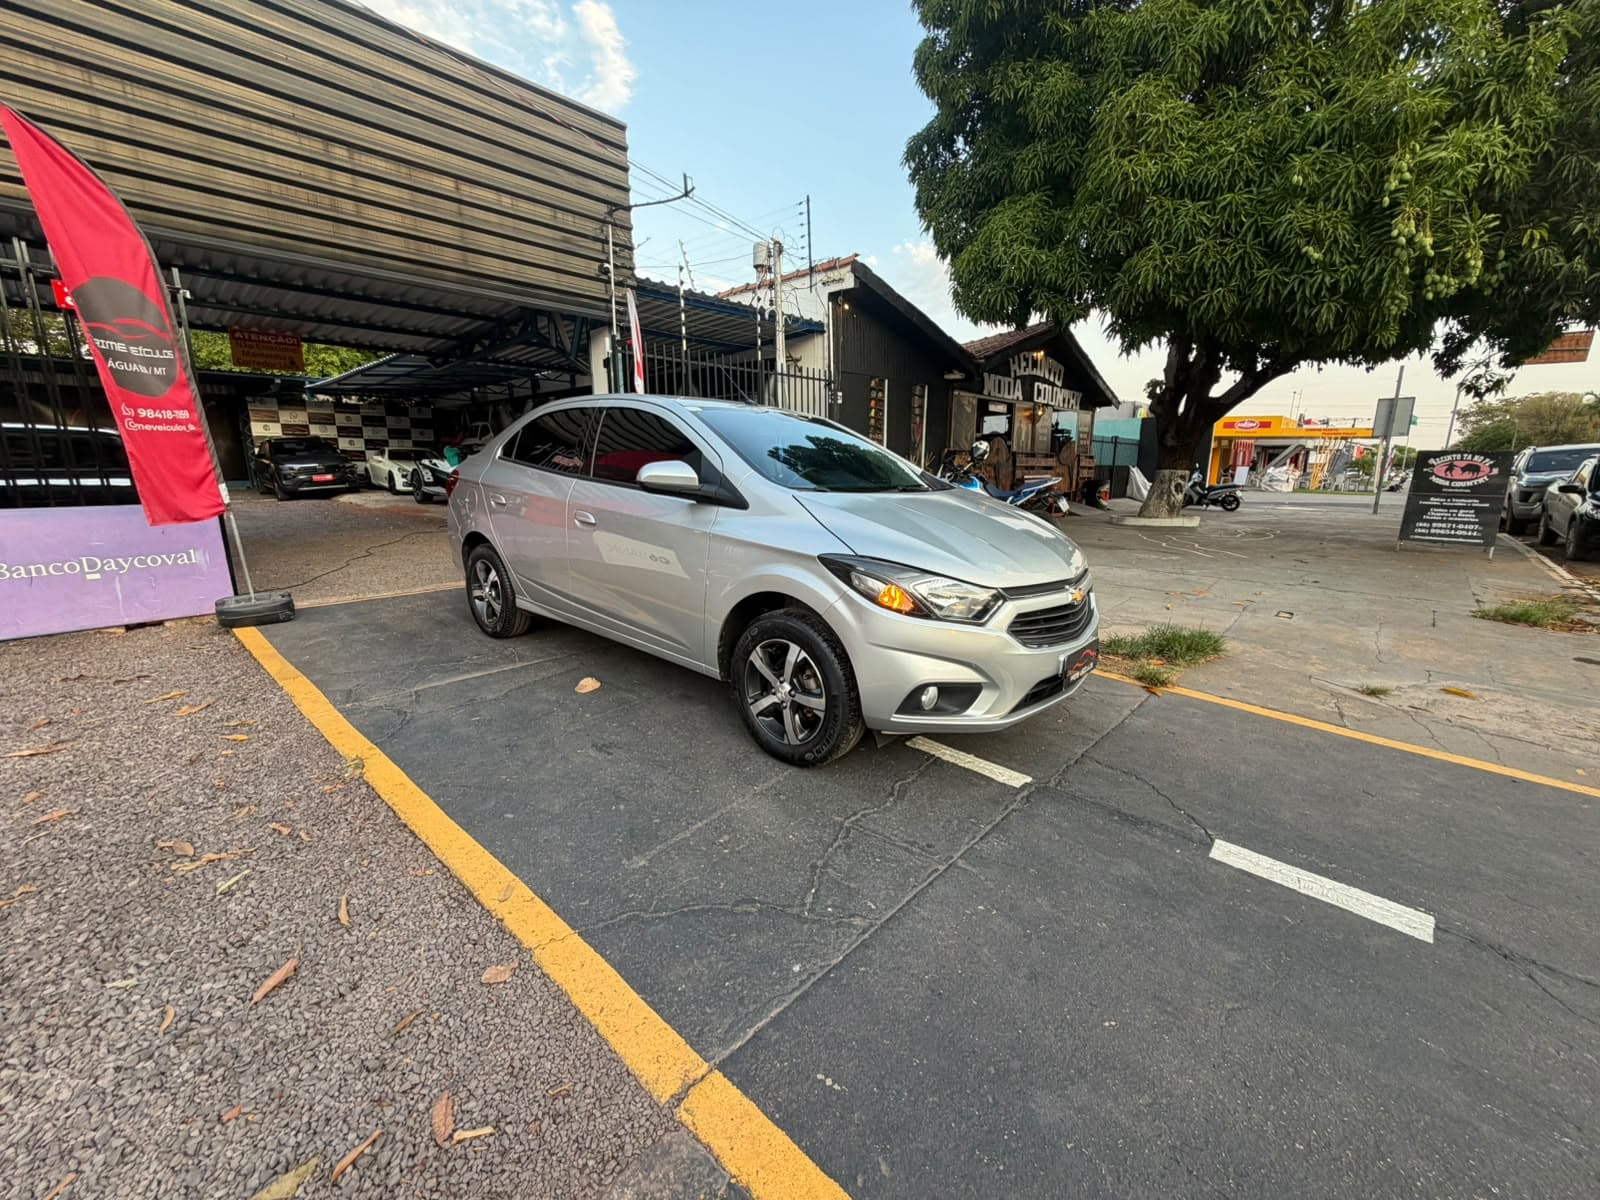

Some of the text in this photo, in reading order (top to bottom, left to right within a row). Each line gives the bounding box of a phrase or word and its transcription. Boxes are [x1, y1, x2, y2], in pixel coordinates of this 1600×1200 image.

[1009, 351, 1065, 388] RECINTO
[983, 372, 1083, 410] MODA COUNTRY
